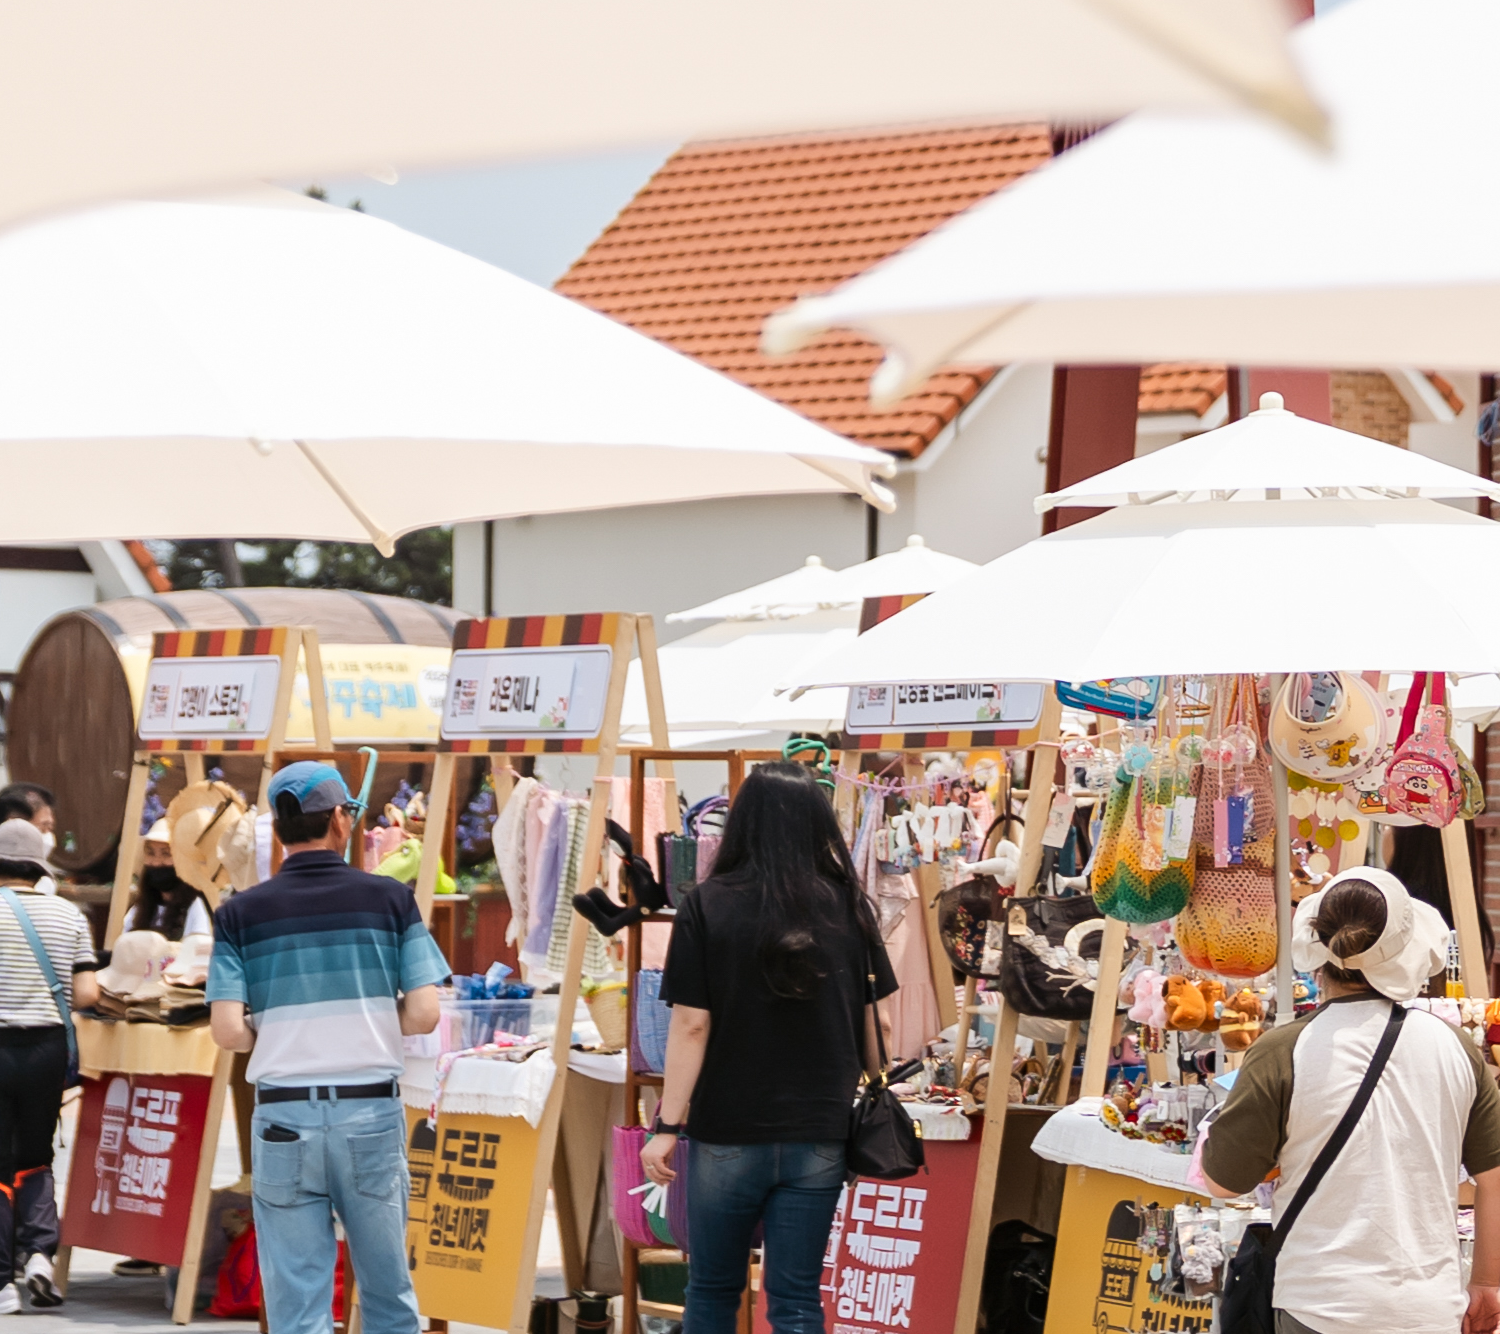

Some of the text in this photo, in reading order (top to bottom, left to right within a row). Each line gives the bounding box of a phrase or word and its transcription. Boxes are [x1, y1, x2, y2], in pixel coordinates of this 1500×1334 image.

[126, 1086, 183, 1154] 도르프
[118, 1152, 171, 1200] 청년마켓
[437, 1128, 501, 1201] 도르프
[429, 1202, 490, 1253] 청년마켓
[846, 1182, 928, 1269] 도르프
[837, 1267, 915, 1329] 청년마켓
